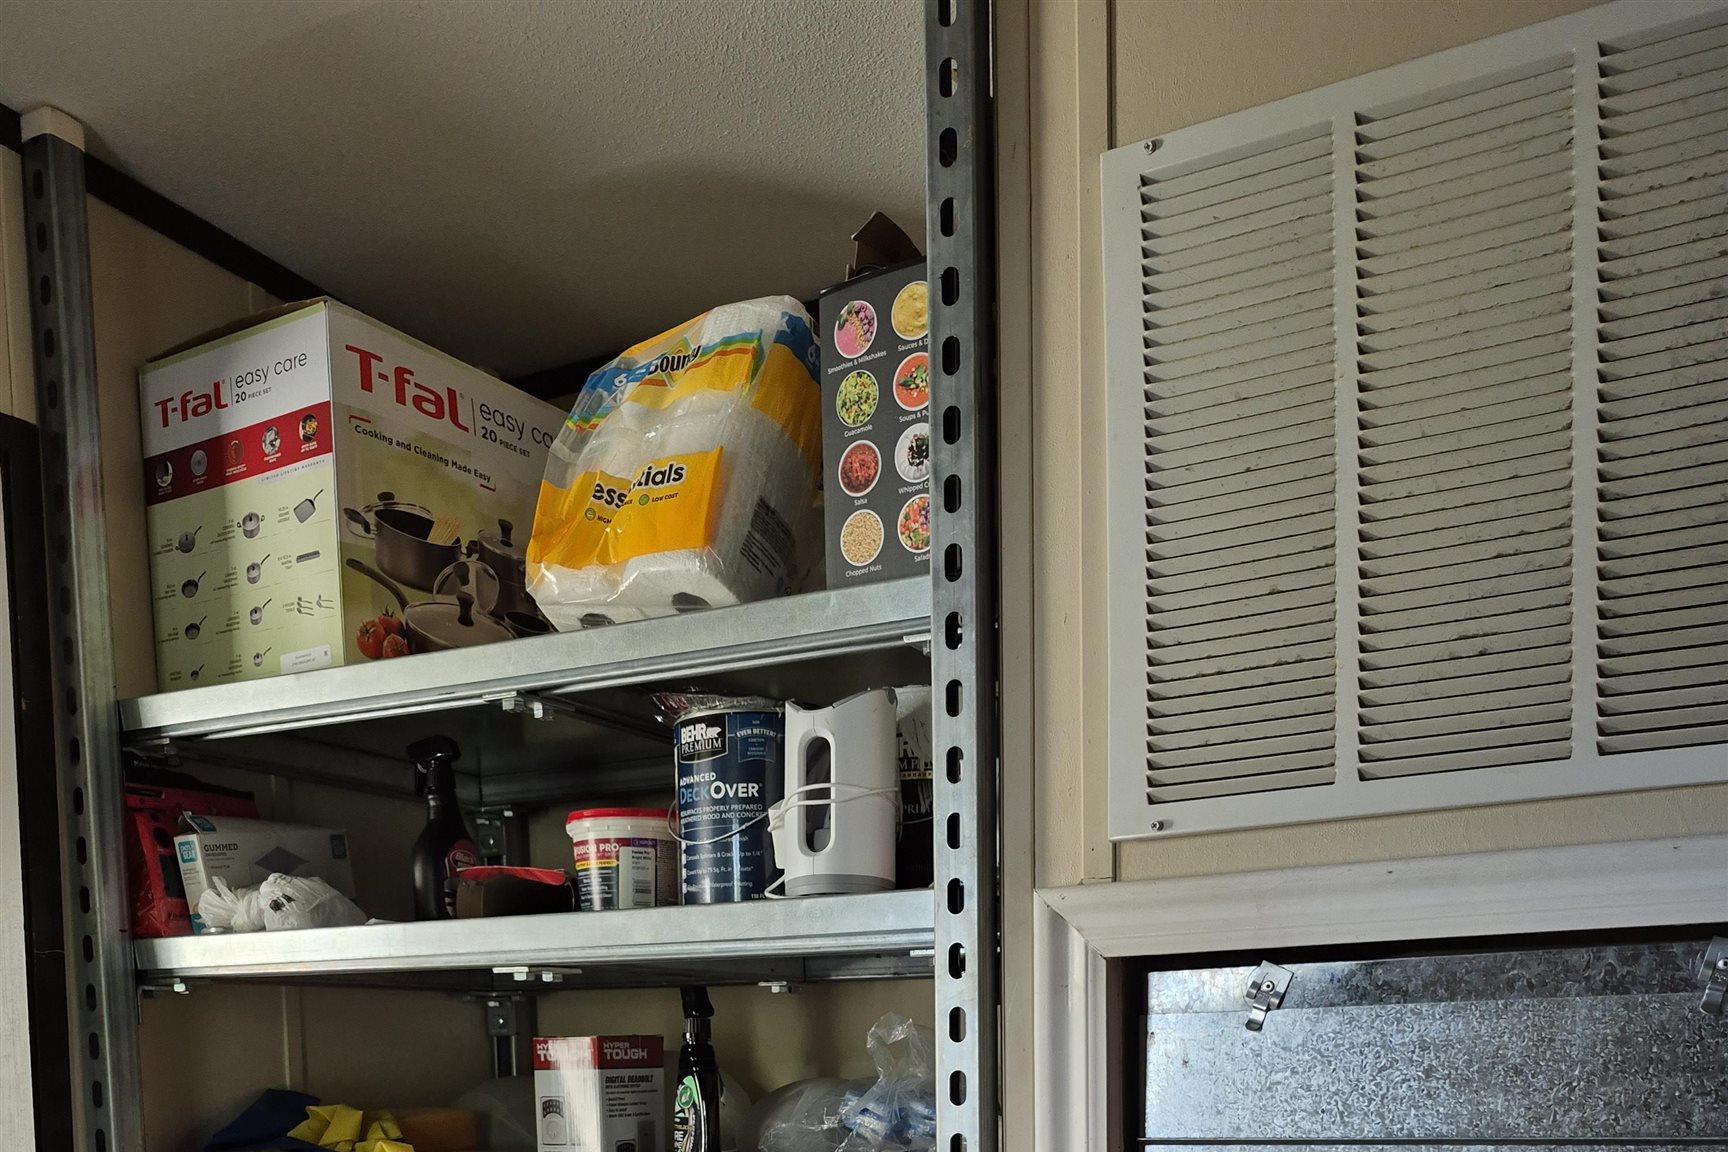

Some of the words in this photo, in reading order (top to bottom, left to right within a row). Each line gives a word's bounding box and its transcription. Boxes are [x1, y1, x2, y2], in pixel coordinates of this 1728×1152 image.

[897, 342, 918, 352] Sauces
[235, 366, 269, 389] easy
[273, 352, 308, 376] care
[827, 360, 853, 375] Smoothies
[345, 344, 470, 433] T-fal
[154, 380, 228, 428] T-fal
[235, 391, 247, 404] 20
[479, 403, 525, 441] easy
[531, 426, 556, 449] ca
[844, 424, 873, 438] Guacamole
[481, 426, 497, 443] 20
[354, 424, 394, 446] Cooking
[395, 438, 412, 452] and
[413, 445, 450, 467] Cleaning
[451, 459, 472, 475] Made
[473, 469, 491, 483] Easy
[592, 463, 685, 509] esstials
[898, 483, 923, 494] Whipped
[854, 498, 868, 506] Salsa
[845, 567, 869, 578] Chopped
[869, 564, 882, 573] Nuts
[681, 723, 707, 744] BEHR
[681, 738, 722, 755] PREMIUM
[680, 772, 717, 786] ADVANCED
[702, 804, 729, 813] PROPERLY
[203, 842, 239, 852] GUMMED
[599, 843, 620, 852] PRO
[604, 1048, 648, 1060] TOUGH
[605, 1075, 626, 1084] DIGITAL
